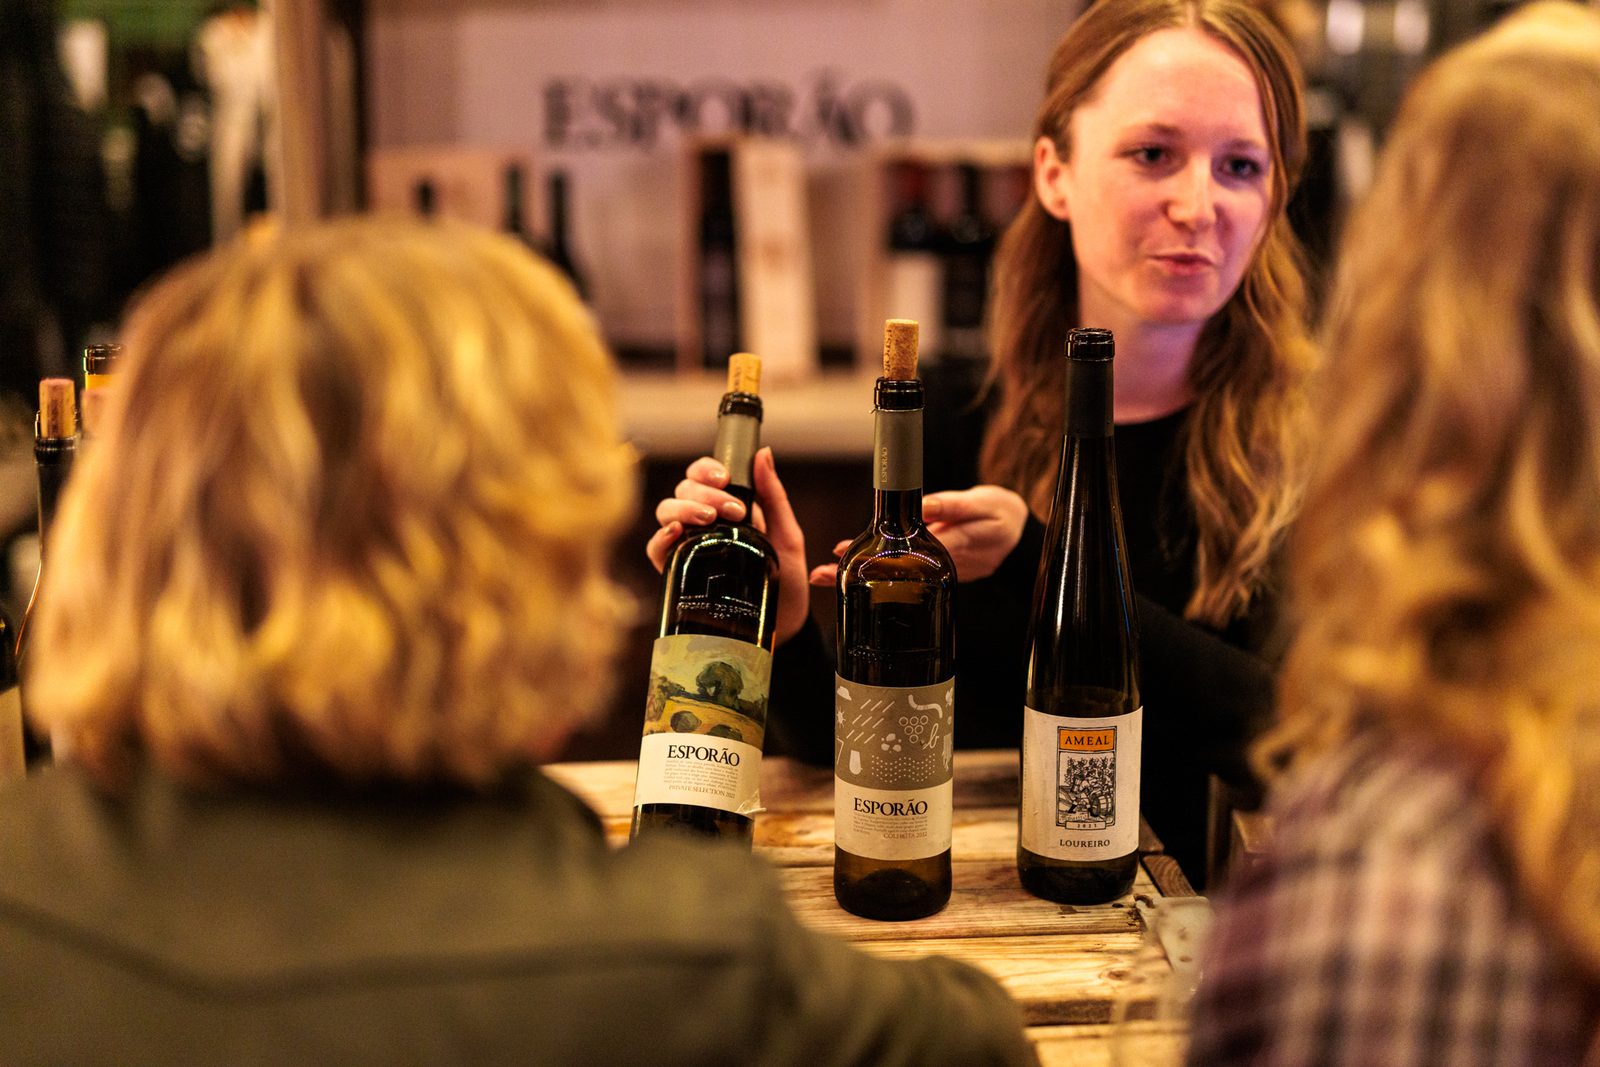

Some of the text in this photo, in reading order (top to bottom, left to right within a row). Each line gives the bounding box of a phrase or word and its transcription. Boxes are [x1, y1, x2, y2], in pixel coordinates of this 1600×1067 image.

[544, 68, 915, 148] ESPORÃO
[1064, 735, 1110, 746] AMEAL
[667, 745, 740, 767] ESPORÃO
[693, 786, 725, 797] SELECTION
[854, 797, 928, 817] ESPORÃO
[1059, 839, 1111, 848] LOUREIRO
